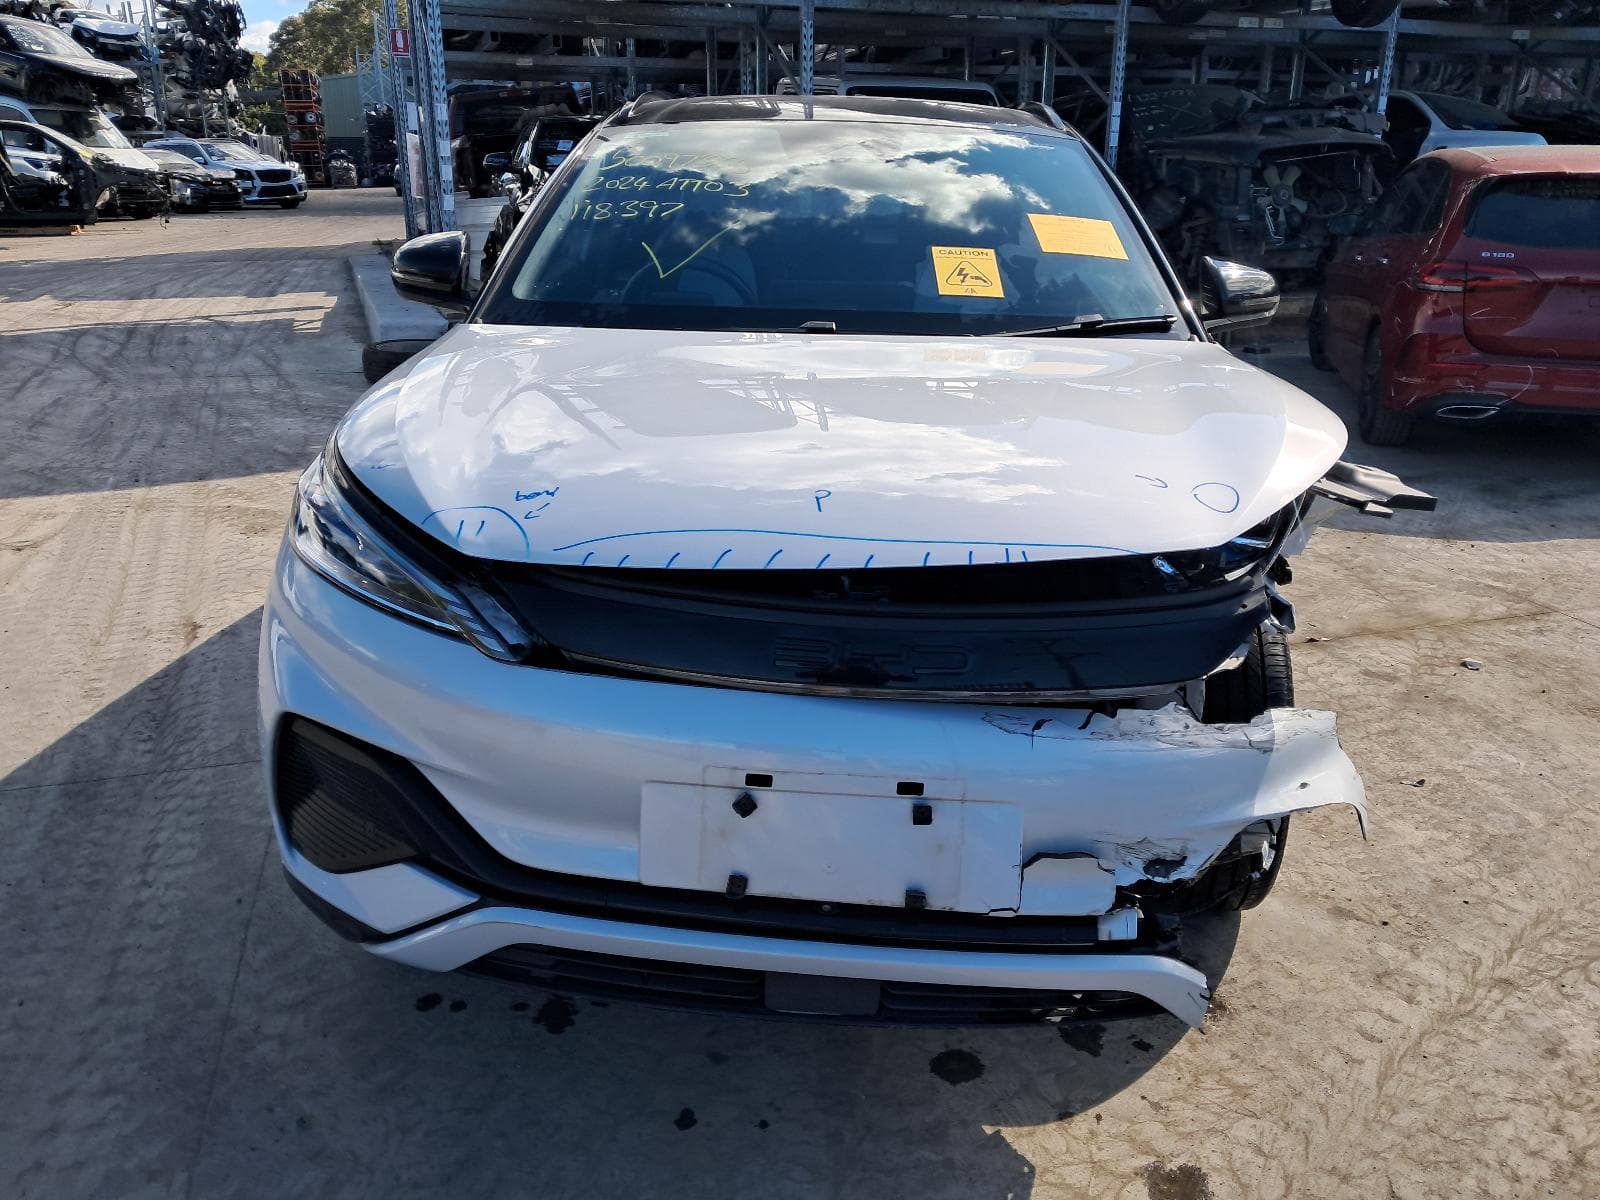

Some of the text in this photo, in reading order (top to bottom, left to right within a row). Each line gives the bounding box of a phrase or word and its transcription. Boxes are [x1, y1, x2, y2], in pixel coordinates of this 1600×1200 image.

[583, 176, 651, 192] 2024
[656, 177, 724, 192] ATTO
[938, 249, 989, 257] CAUTION
[815, 489, 832, 512] P
